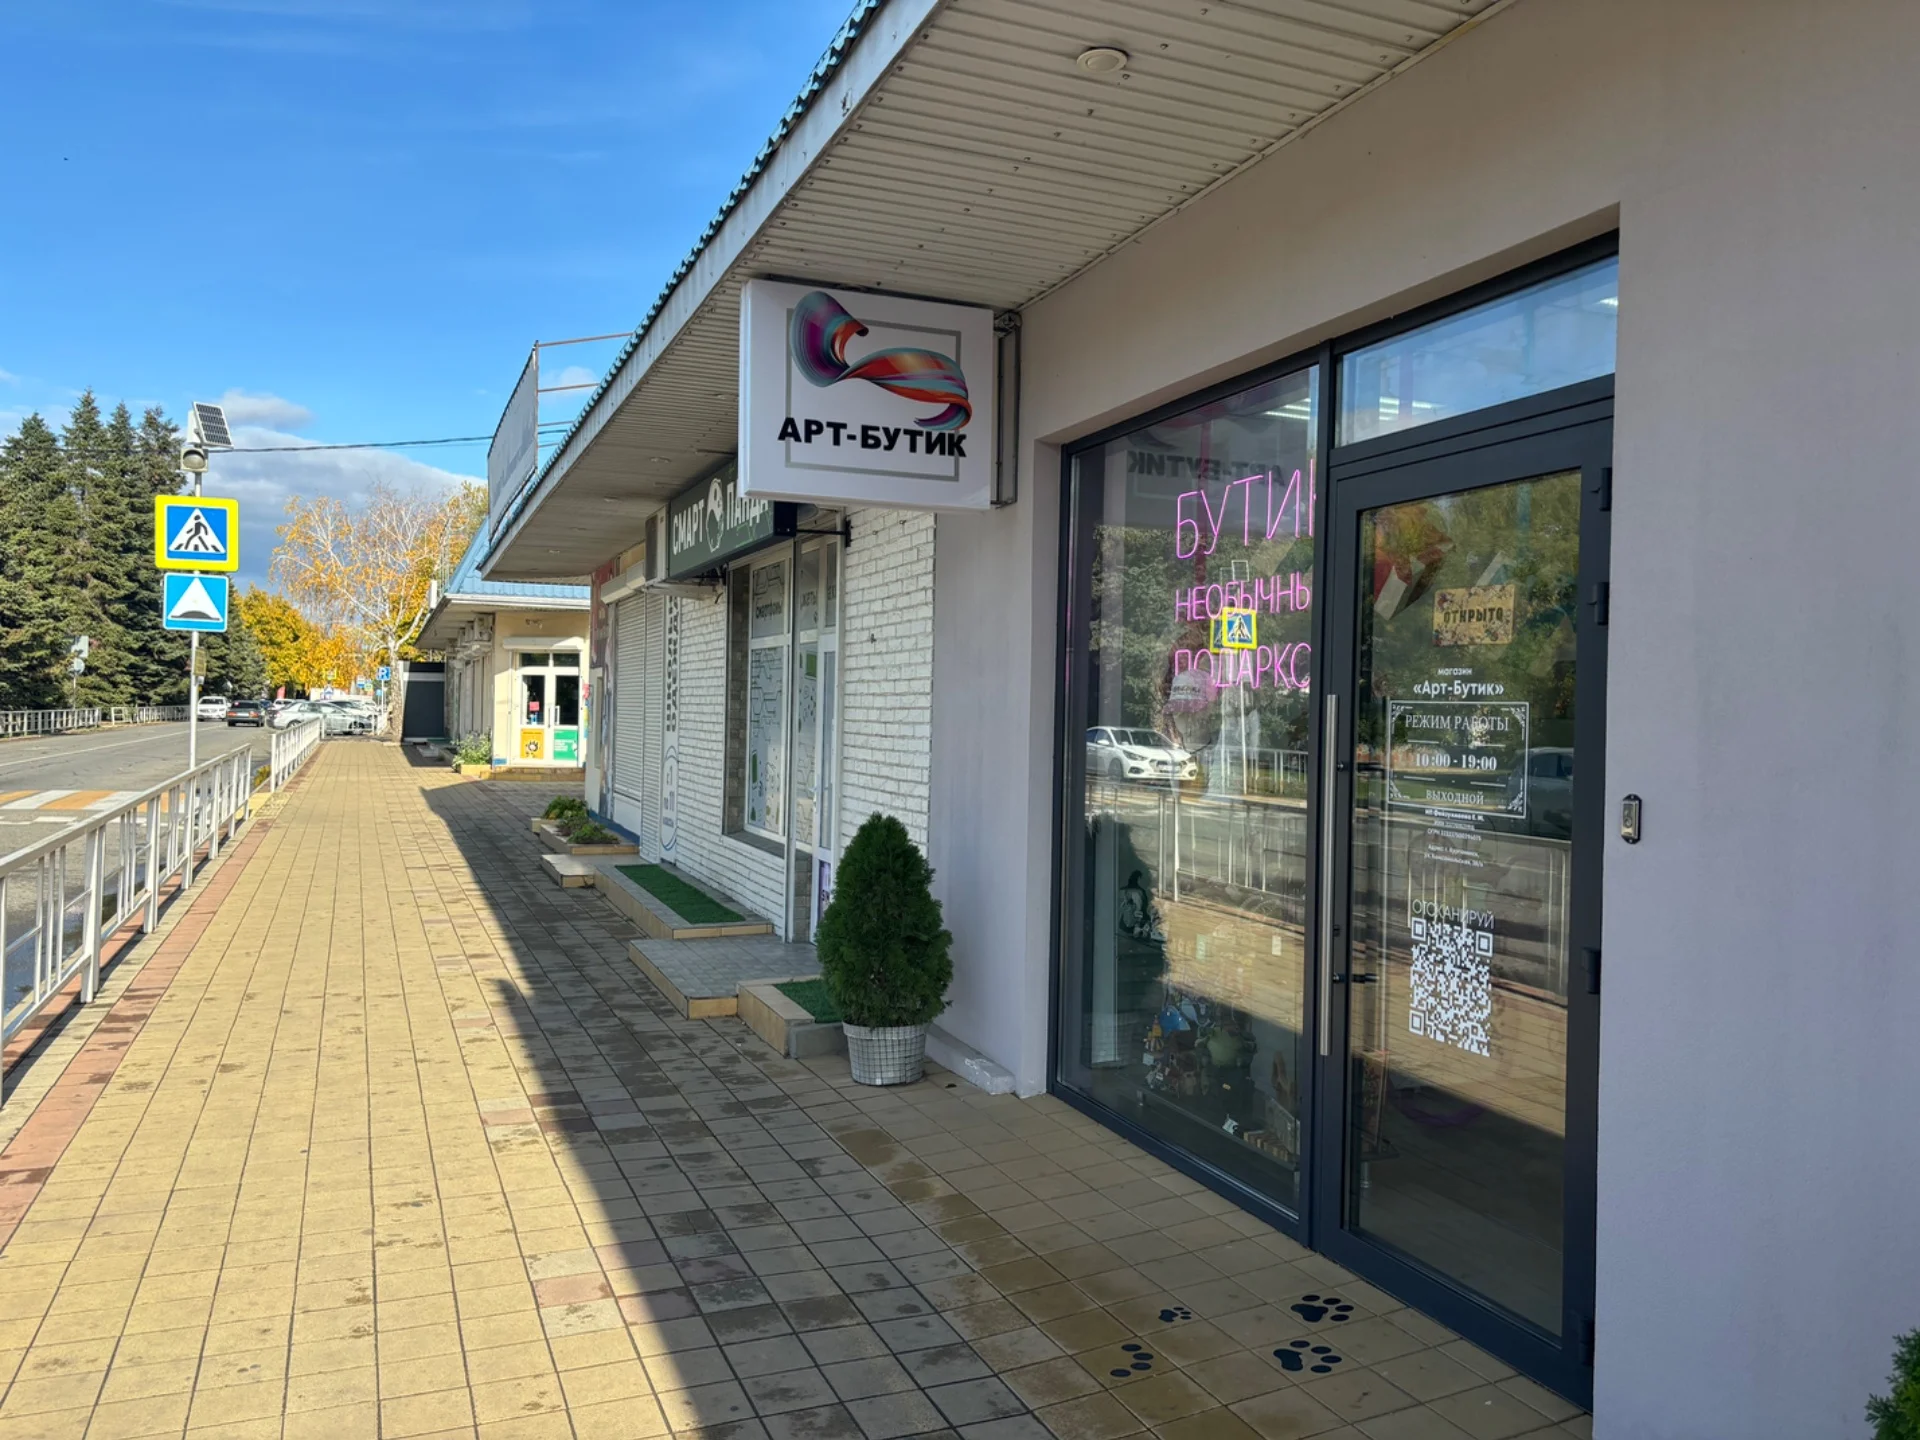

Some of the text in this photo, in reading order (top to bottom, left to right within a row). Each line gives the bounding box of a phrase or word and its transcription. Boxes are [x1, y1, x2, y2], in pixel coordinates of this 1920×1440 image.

[777, 417, 967, 458] АРТ-БУТИК
[673, 498, 705, 556] СМАРТ
[1443, 607, 1503, 624] ОТКРЫТО
[1437, 667, 1473, 676] магазин
[1413, 680, 1504, 698] «Арт-Бутик»
[1405, 714, 1509, 732] РЕЖИМ РАБОТЫ
[1416, 753, 1451, 768] 10:00
[1462, 754, 1498, 771] 19:00
[1425, 789, 1485, 805] ВЫХОДНОЙ
[1412, 899, 1495, 930] ОТСКАНИРУЙ
